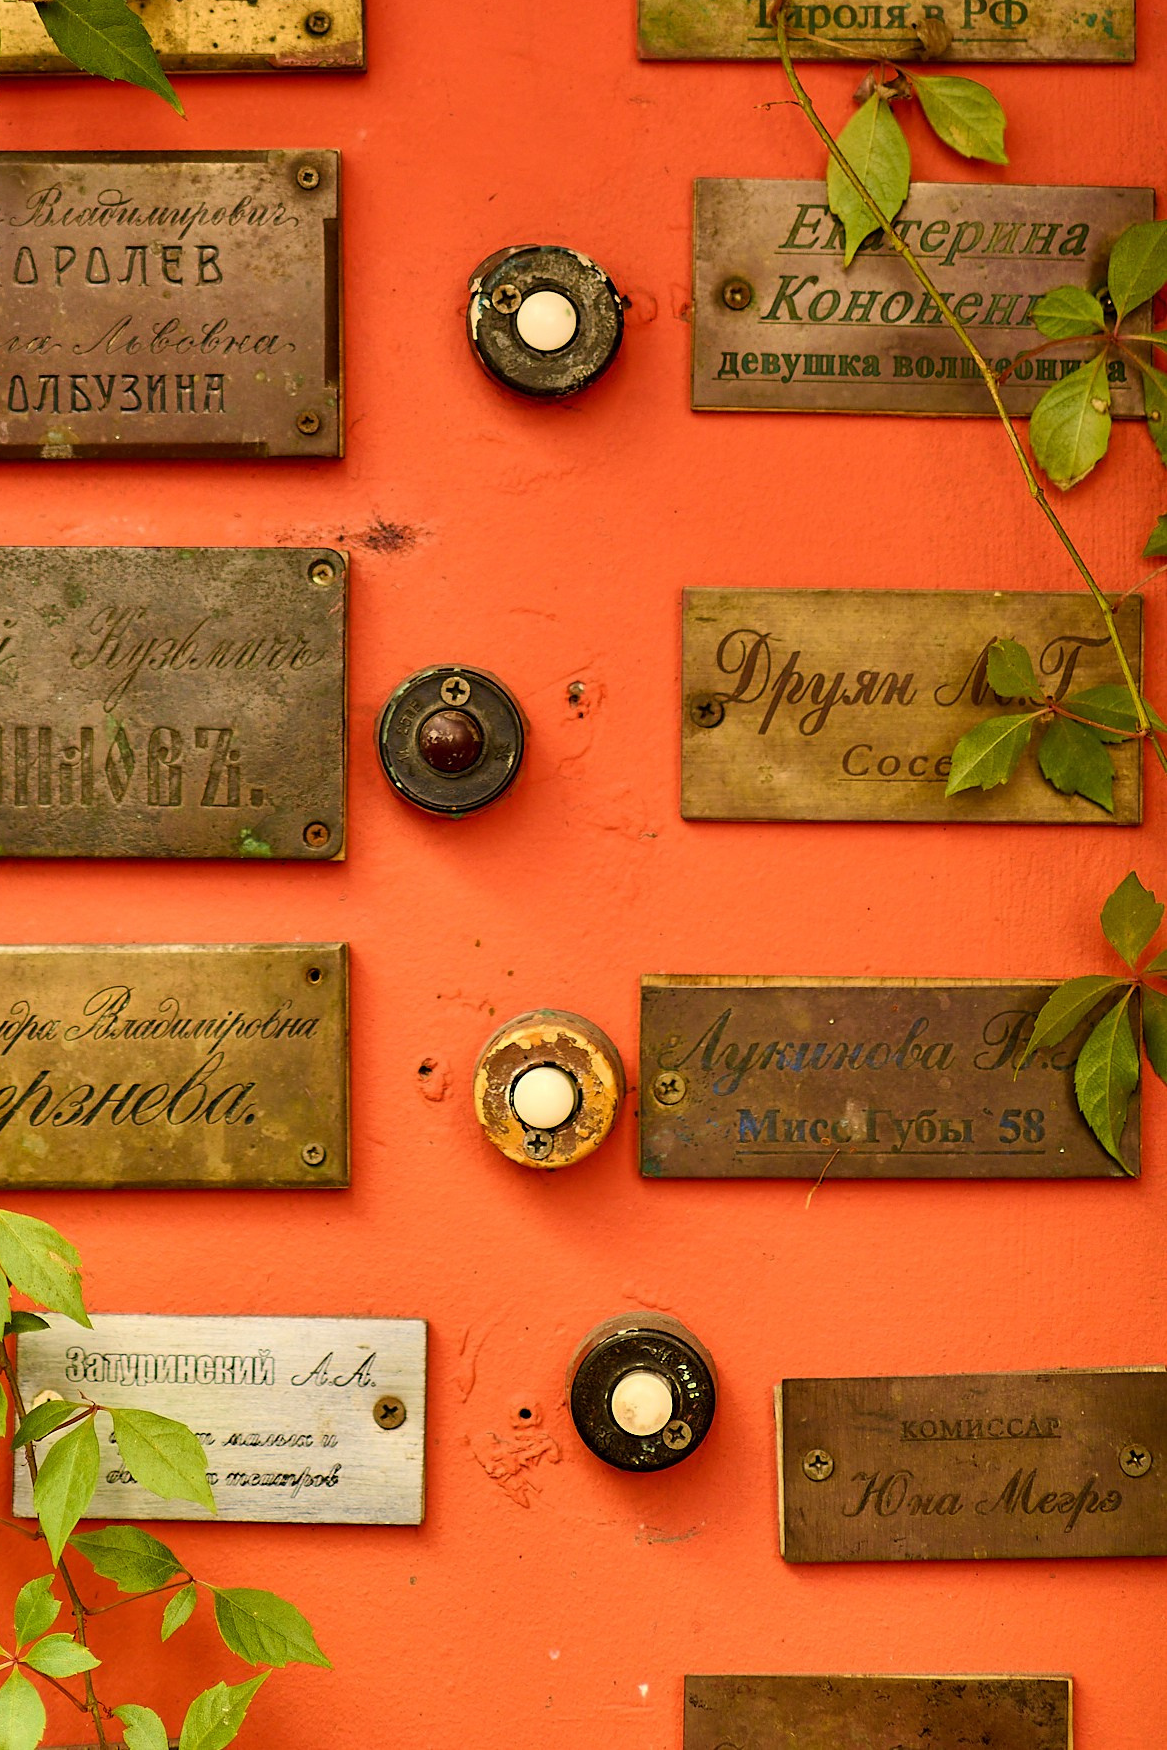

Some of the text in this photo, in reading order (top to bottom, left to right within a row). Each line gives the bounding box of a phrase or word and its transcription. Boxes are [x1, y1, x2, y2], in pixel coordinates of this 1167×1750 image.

[10, 182, 299, 240] Владимирович
[73, 314, 297, 356] Львовна
[717, 350, 882, 383] девушка
[716, 628, 916, 735] Друян
[657, 1007, 956, 1096] Лукинова
[736, 1107, 842, 1145] Мисс
[866, 1107, 975, 1151] Губы
[65, 1346, 377, 1388] Затуринский А.А.
[223, 1431, 315, 1449] малых
[321, 1432, 339, 1449] и
[901, 1418, 1062, 1440] КОМИССАР
[225, 1463, 343, 1499] театров
[841, 1467, 1124, 1533] Юна Мегрэ
